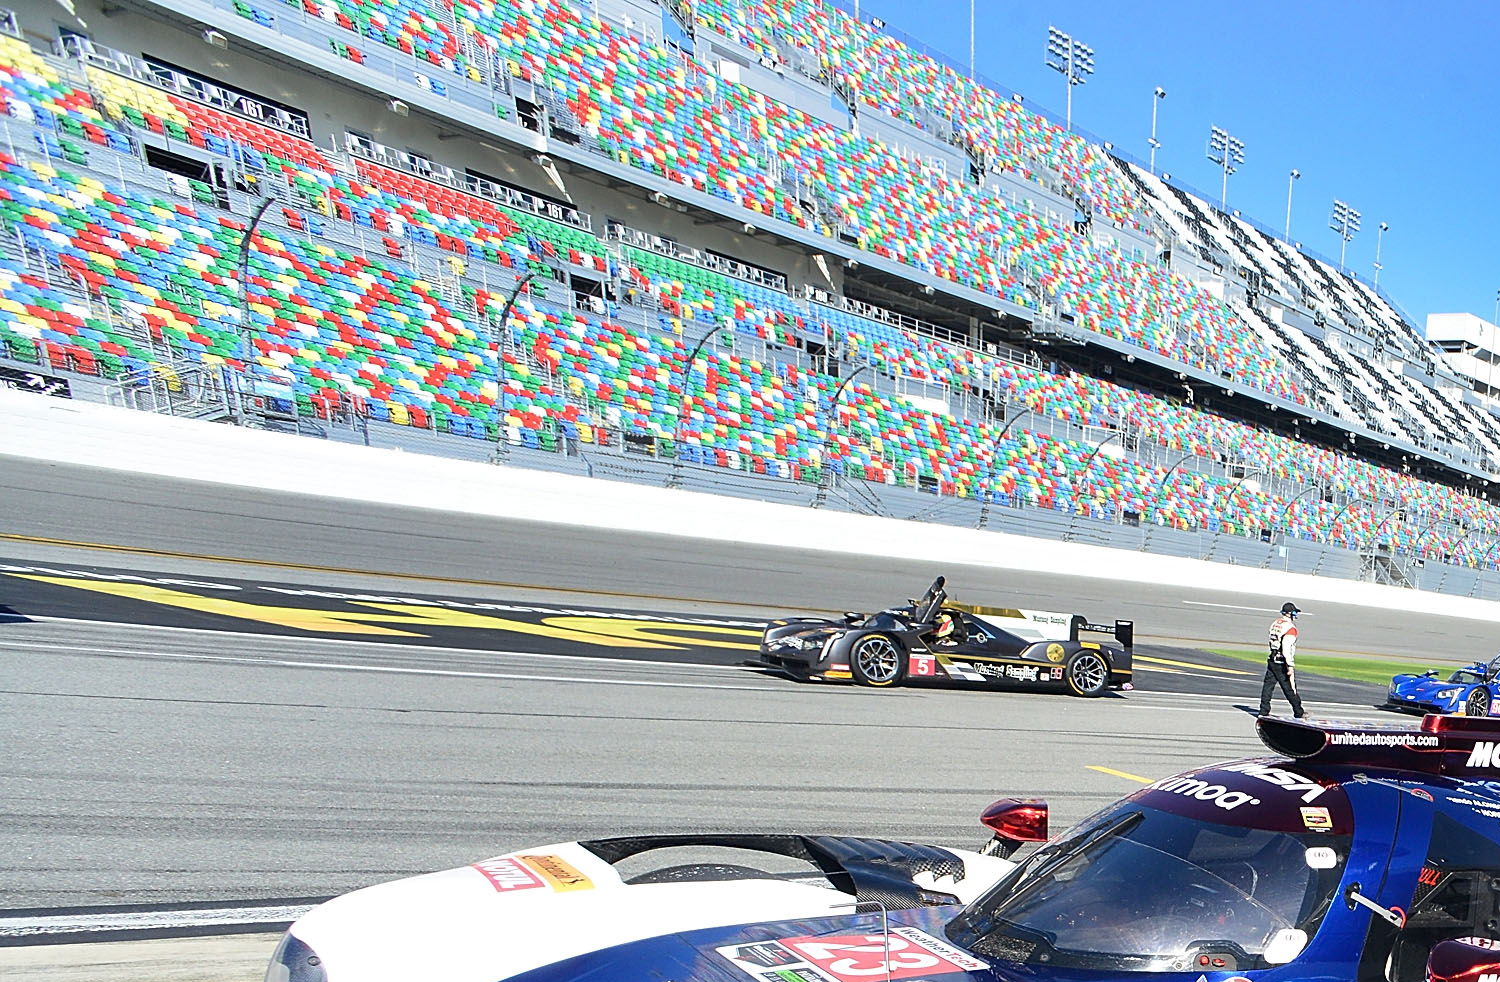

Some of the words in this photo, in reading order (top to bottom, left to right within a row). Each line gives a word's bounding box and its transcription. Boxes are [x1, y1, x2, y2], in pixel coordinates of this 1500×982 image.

[239, 97, 264, 119] 161
[546, 203, 563, 220] 161
[917, 659, 929, 675] 5
[1330, 732, 1439, 748] unitedautosports.com
[1146, 774, 1254, 811] kimoa
[479, 858, 536, 889] MOTUL
[792, 936, 940, 976] 23
[901, 928, 980, 969] WeatherTech
